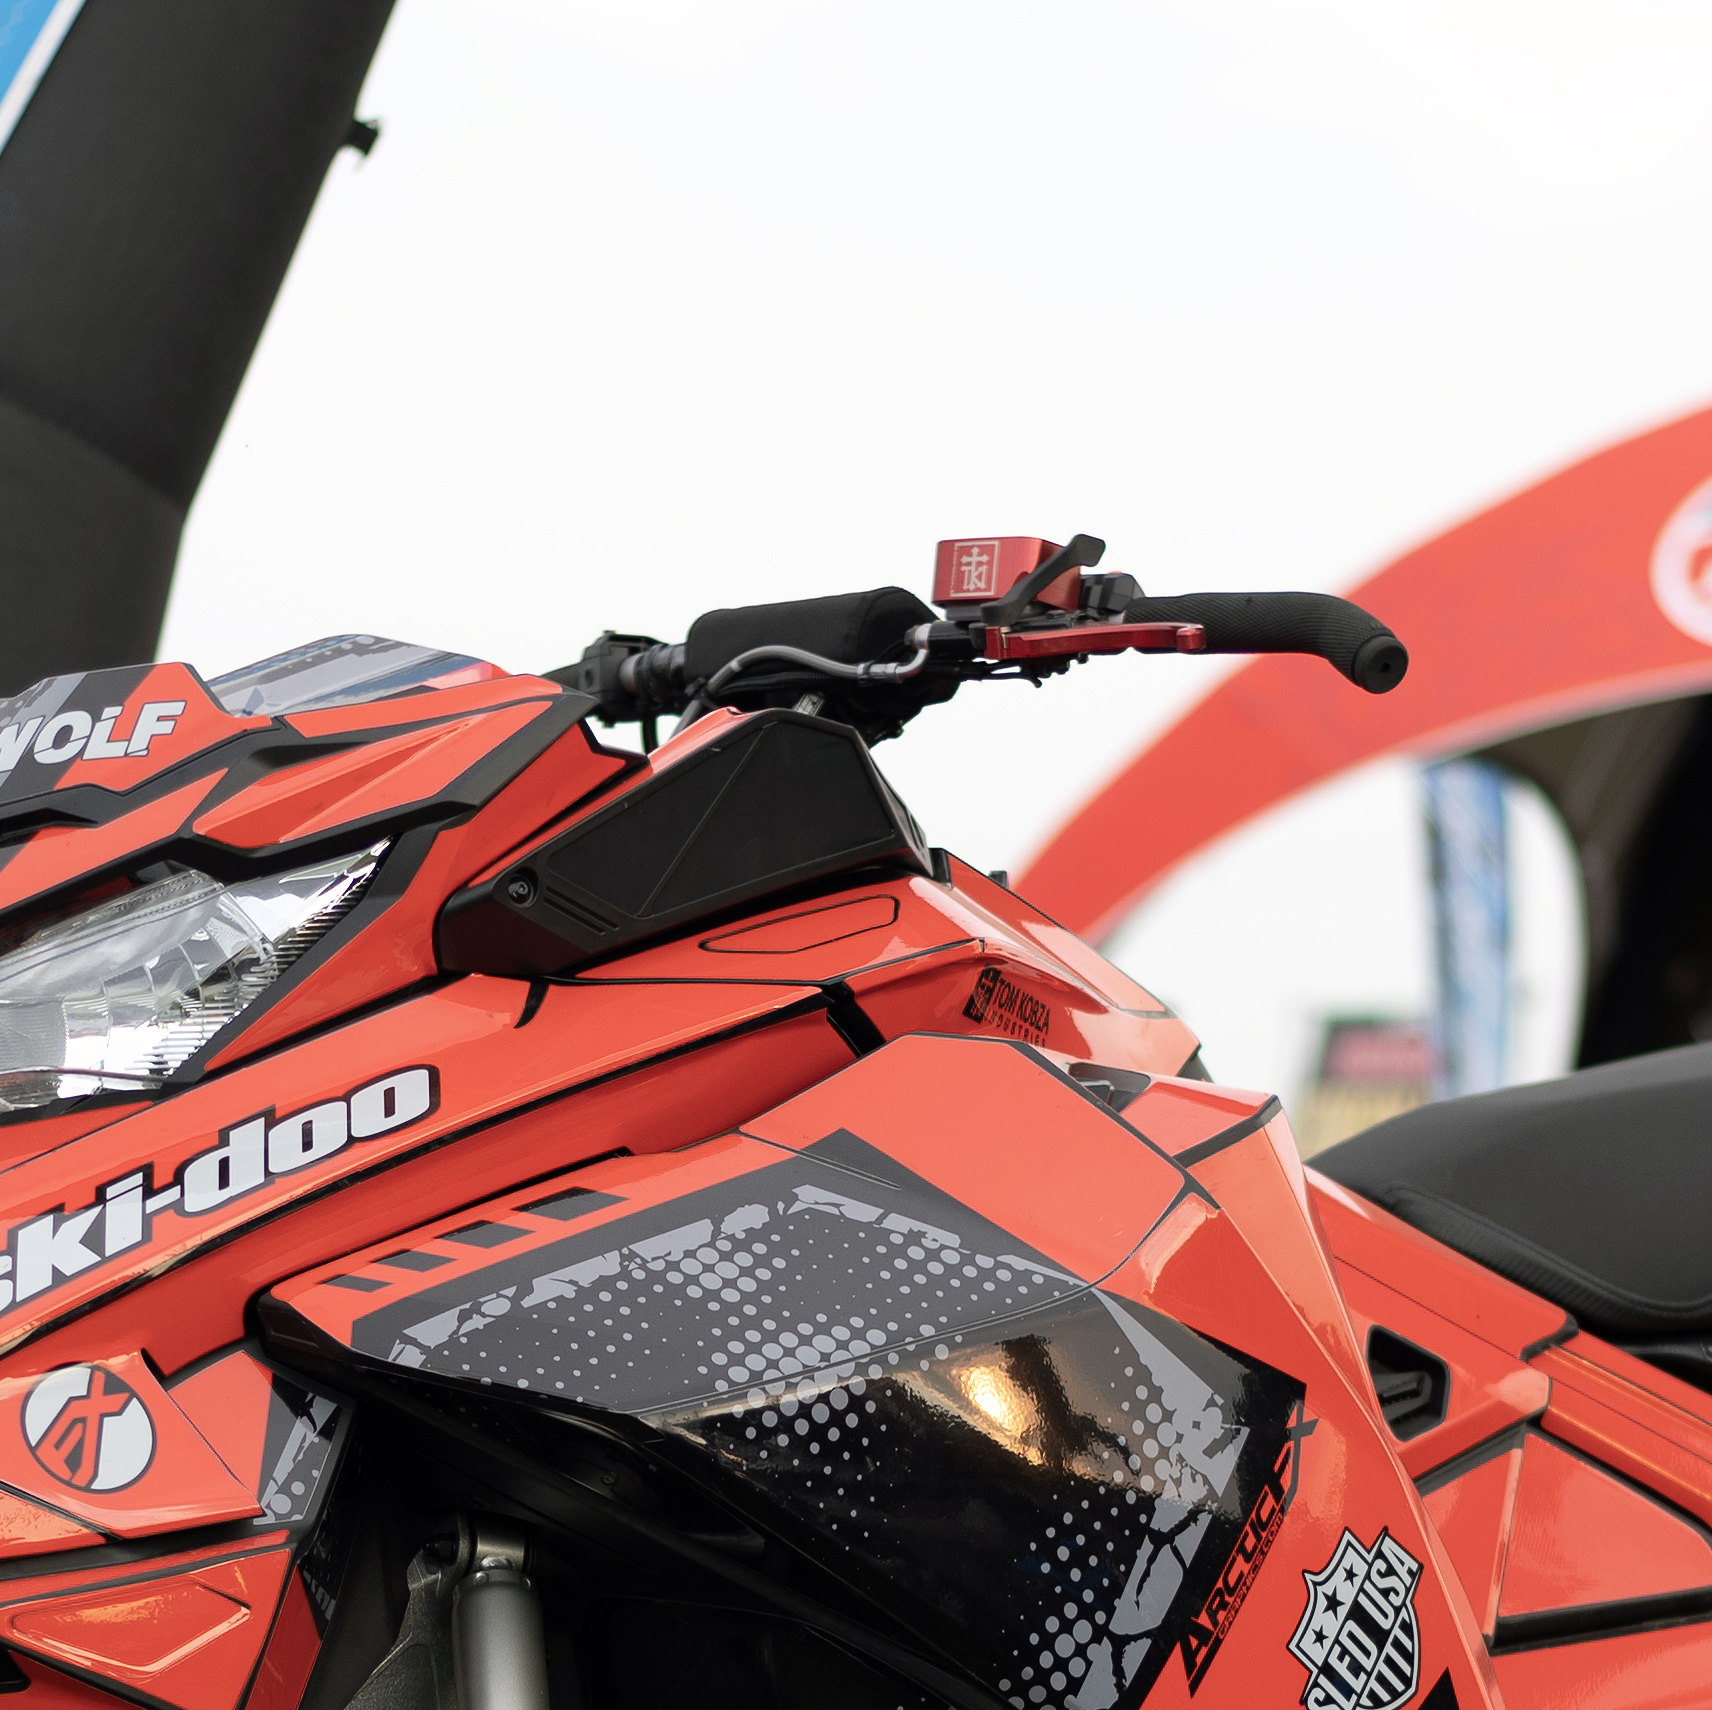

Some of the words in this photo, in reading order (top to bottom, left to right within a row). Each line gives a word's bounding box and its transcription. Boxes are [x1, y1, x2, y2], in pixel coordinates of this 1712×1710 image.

[992, 977, 1021, 1016] TOM
[1016, 991, 1051, 1036] KOBZA
[1357, 1535, 1420, 1631] USA
